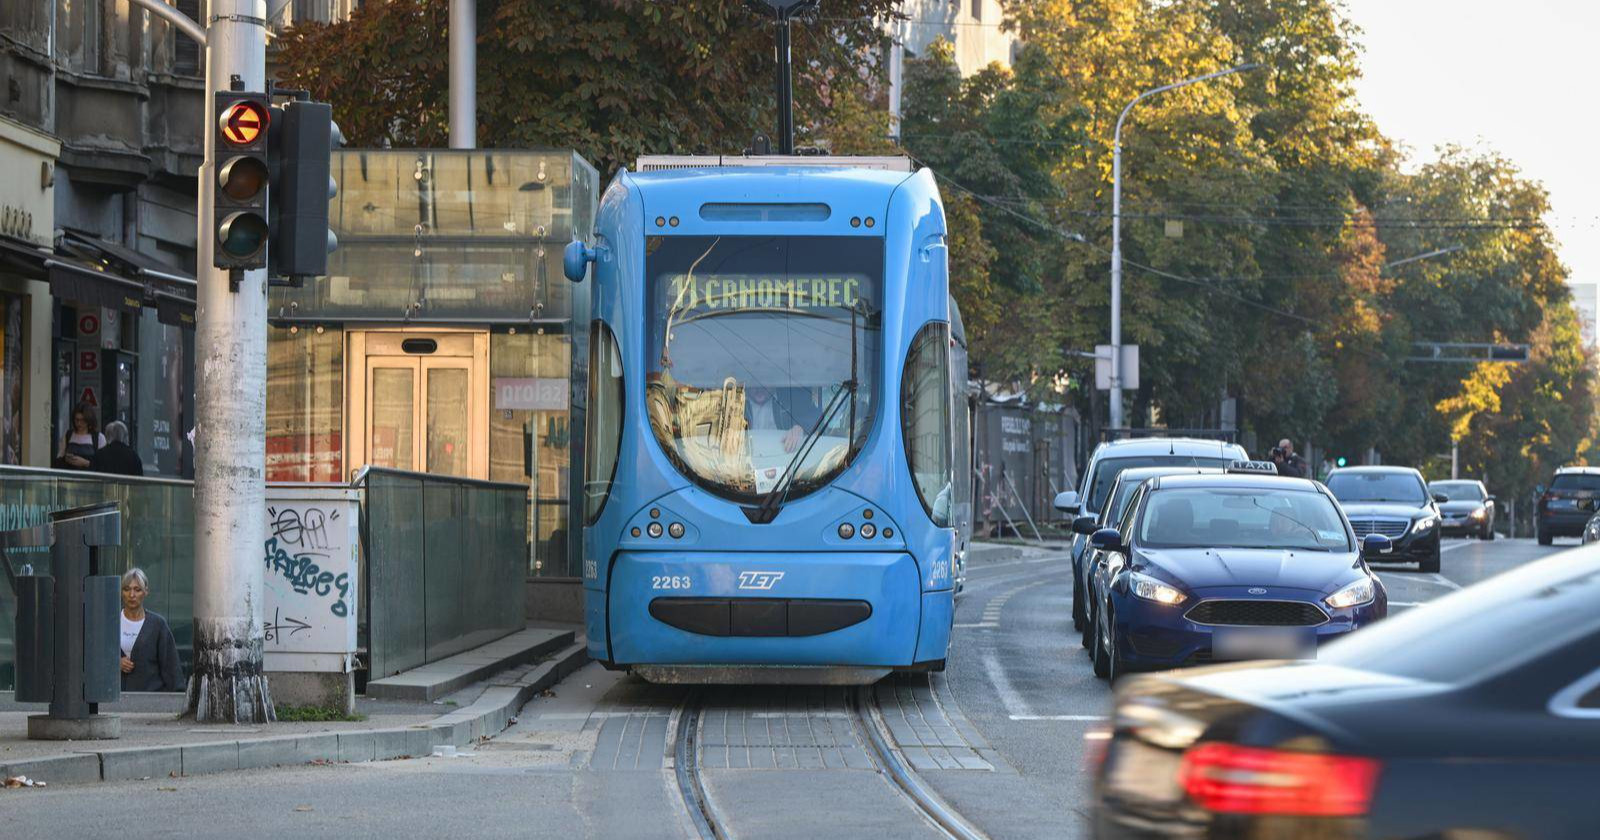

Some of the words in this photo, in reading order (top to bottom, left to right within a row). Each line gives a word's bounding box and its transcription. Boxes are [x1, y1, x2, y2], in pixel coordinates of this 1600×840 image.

[502, 383, 562, 405] prolaz
[1235, 460, 1272, 470] TAXI
[652, 576, 691, 590] 2263
[738, 571, 786, 590] ZET
